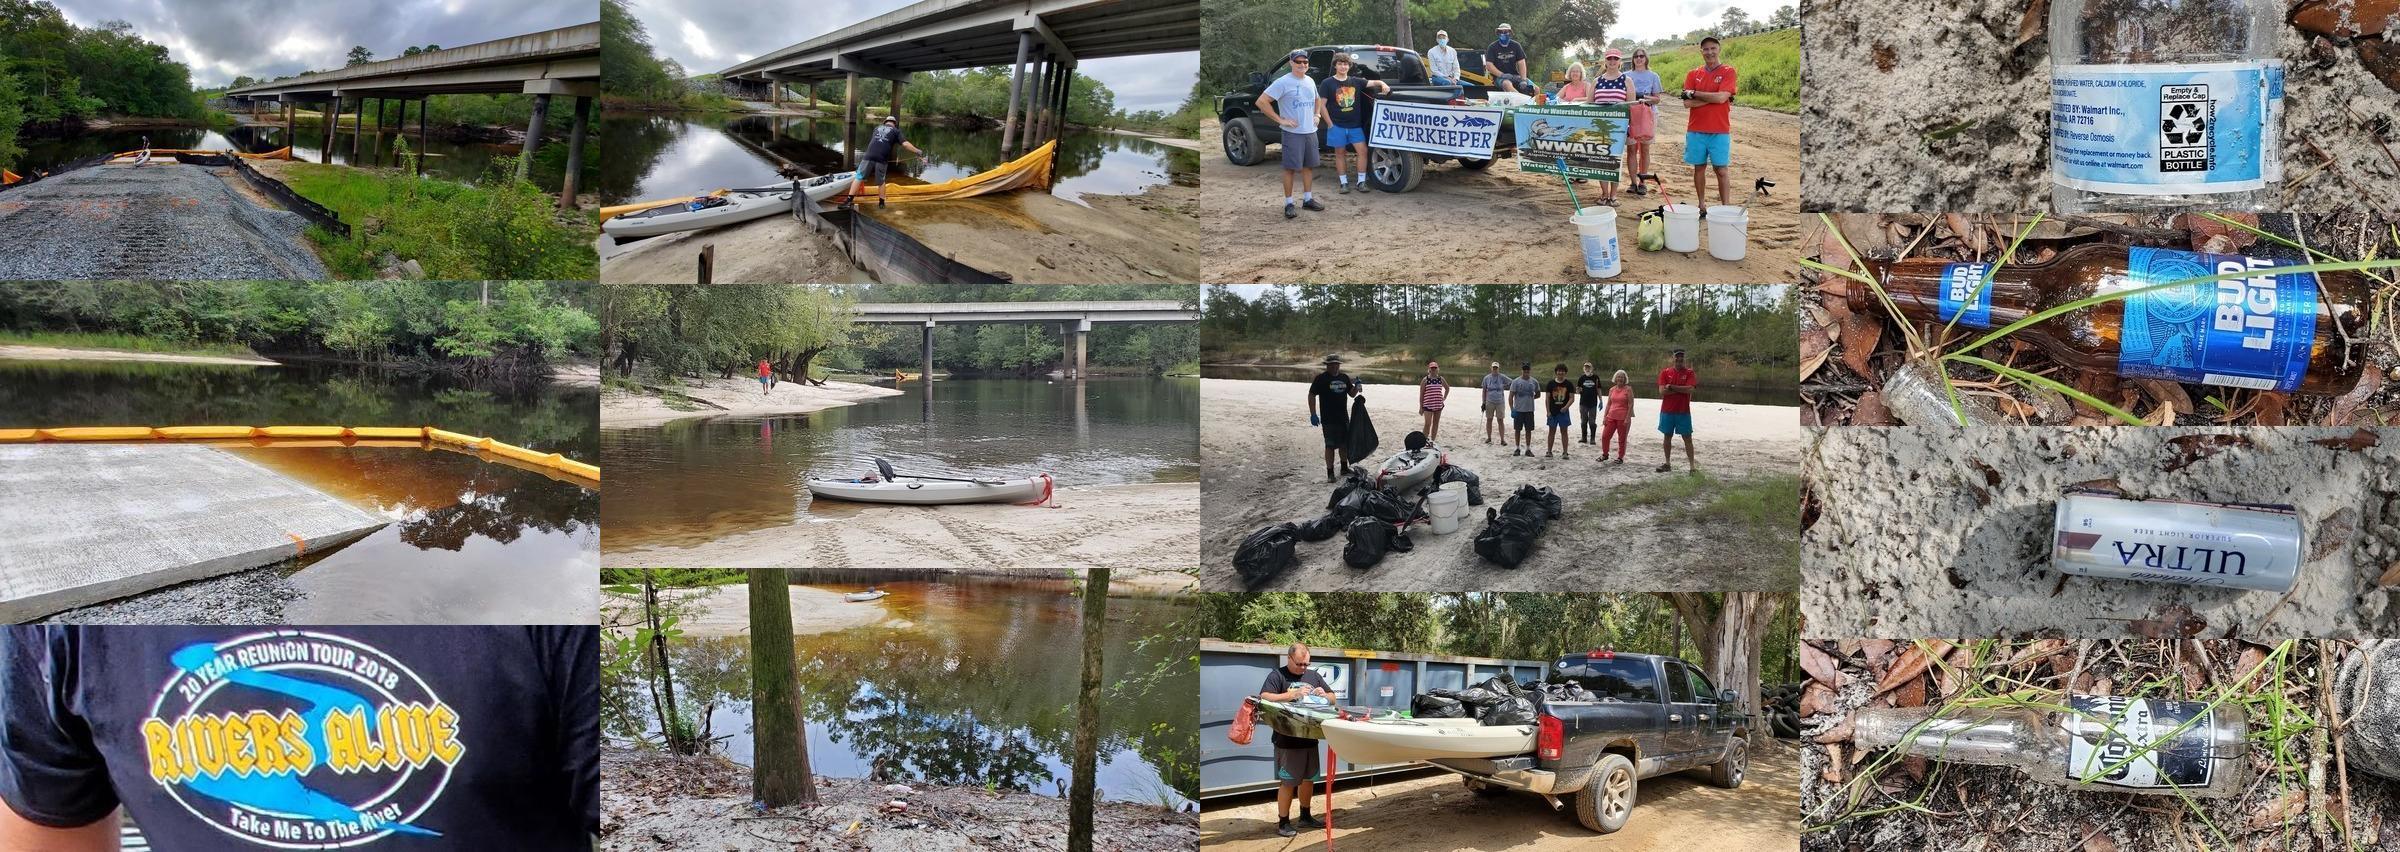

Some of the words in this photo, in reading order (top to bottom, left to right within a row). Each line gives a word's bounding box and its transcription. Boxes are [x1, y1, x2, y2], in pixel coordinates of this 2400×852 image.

[2095, 80, 2117, 88] CALCIUM
[2118, 80, 2147, 88] CHLORIDE,
[2170, 87, 2193, 95] Empty
[1518, 107, 1541, 115] Working
[1550, 108, 1583, 116] Watershed
[1583, 109, 1627, 118] Conservation
[2072, 105, 2081, 114] BY:
[2081, 105, 2108, 115] Walmart
[2109, 106, 2126, 117] Inc.,
[1382, 107, 1449, 128] Suwannee
[2069, 114, 2077, 124] AR
[2077, 116, 2094, 126] 72716
[1375, 122, 1492, 149] RIVERKEEPER
[2070, 131, 2089, 141] Reverse
[2090, 132, 2115, 143] Osmosis
[2209, 99, 2217, 171] how2recycle.info
[1534, 138, 1611, 156] WWALS
[2080, 149, 2109, 158] replacement
[2116, 152, 2136, 160] money
[2164, 150, 2205, 159] PLASTIC
[2085, 160, 2100, 168] online
[2107, 161, 2144, 170] walmart.com
[2166, 161, 2203, 170] BOTTLE
[1572, 167, 1617, 177] Coalition
[1950, 266, 1968, 302] BUD
[1965, 264, 1985, 311] LIGHT
[2214, 261, 2247, 333] BUD
[2242, 256, 2278, 350] LIGHT
[2188, 532, 2232, 542] SUPERIOR
[178, 679, 202, 704] 20
[195, 652, 240, 687] YEAR
[311, 643, 356, 670] TOUR
[357, 655, 401, 691] 2018
[143, 708, 316, 784] RIVERS
[323, 701, 465, 775] ALIVE
[230, 807, 271, 836] Take
[274, 819, 300, 840] Me
[303, 820, 324, 840] To
[326, 819, 360, 840] The
[359, 802, 404, 834] River
